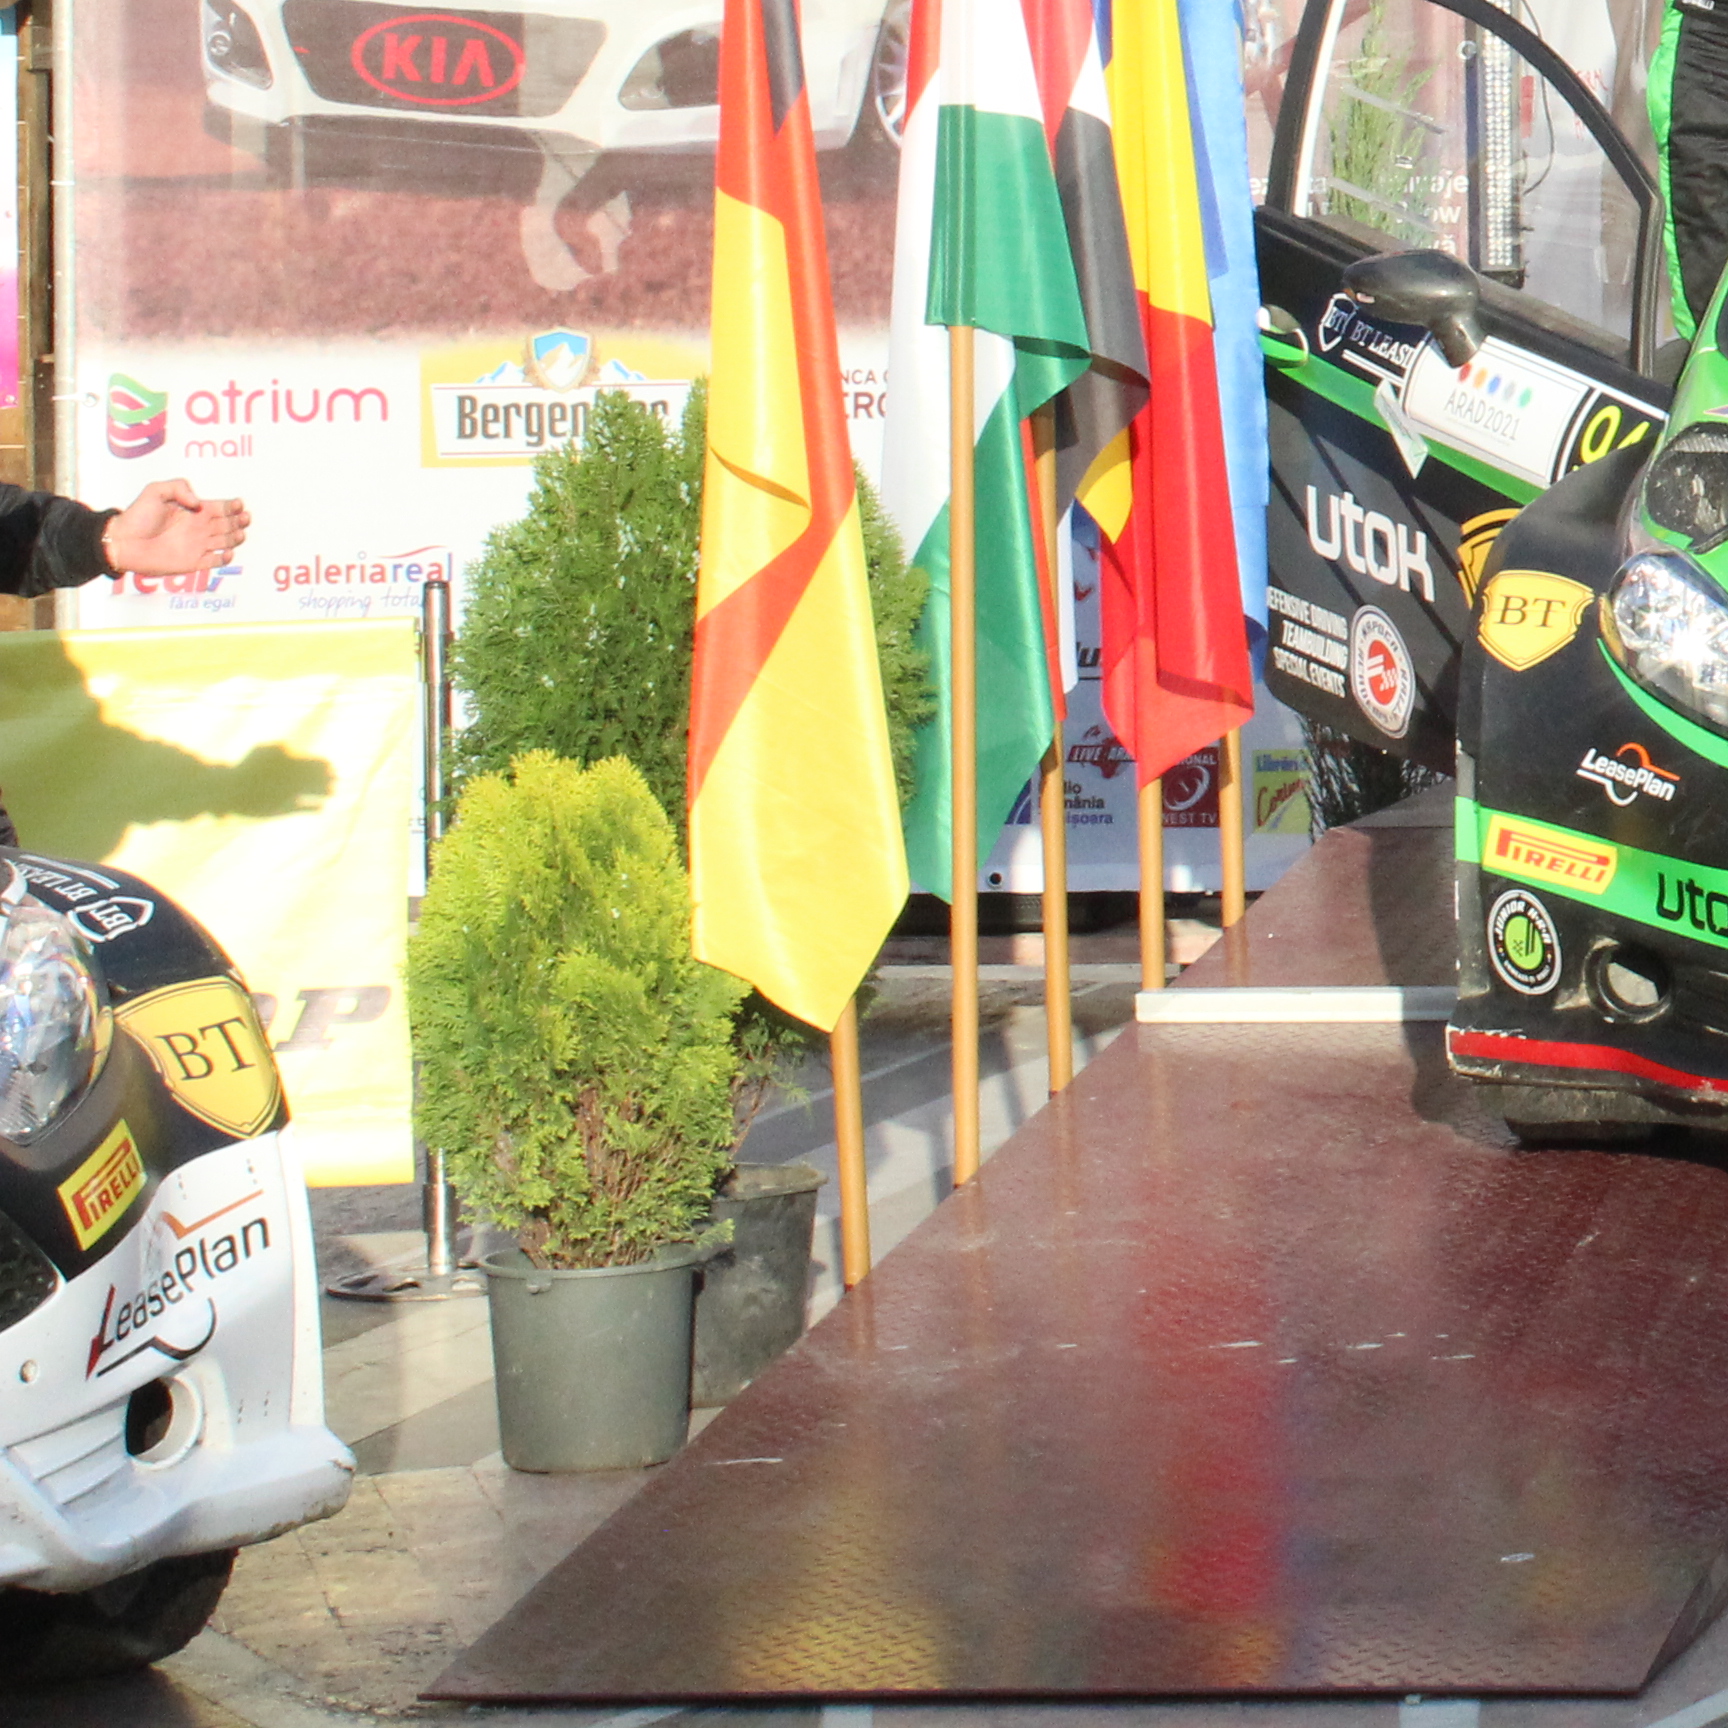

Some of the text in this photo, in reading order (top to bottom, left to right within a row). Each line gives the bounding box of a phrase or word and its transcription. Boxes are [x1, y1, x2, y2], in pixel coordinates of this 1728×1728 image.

[381, 32, 496, 88] KIA
[185, 378, 389, 425] atrium
[185, 436, 254, 459] mall
[1495, 594, 1566, 627] BT
[1580, 747, 1676, 800] LeasePlan
[1495, 828, 1611, 883] PIRELLI
[162, 1016, 257, 1082] BT
[72, 1135, 138, 1232] PIRELLI
[100, 1216, 270, 1351] LeasePlan
